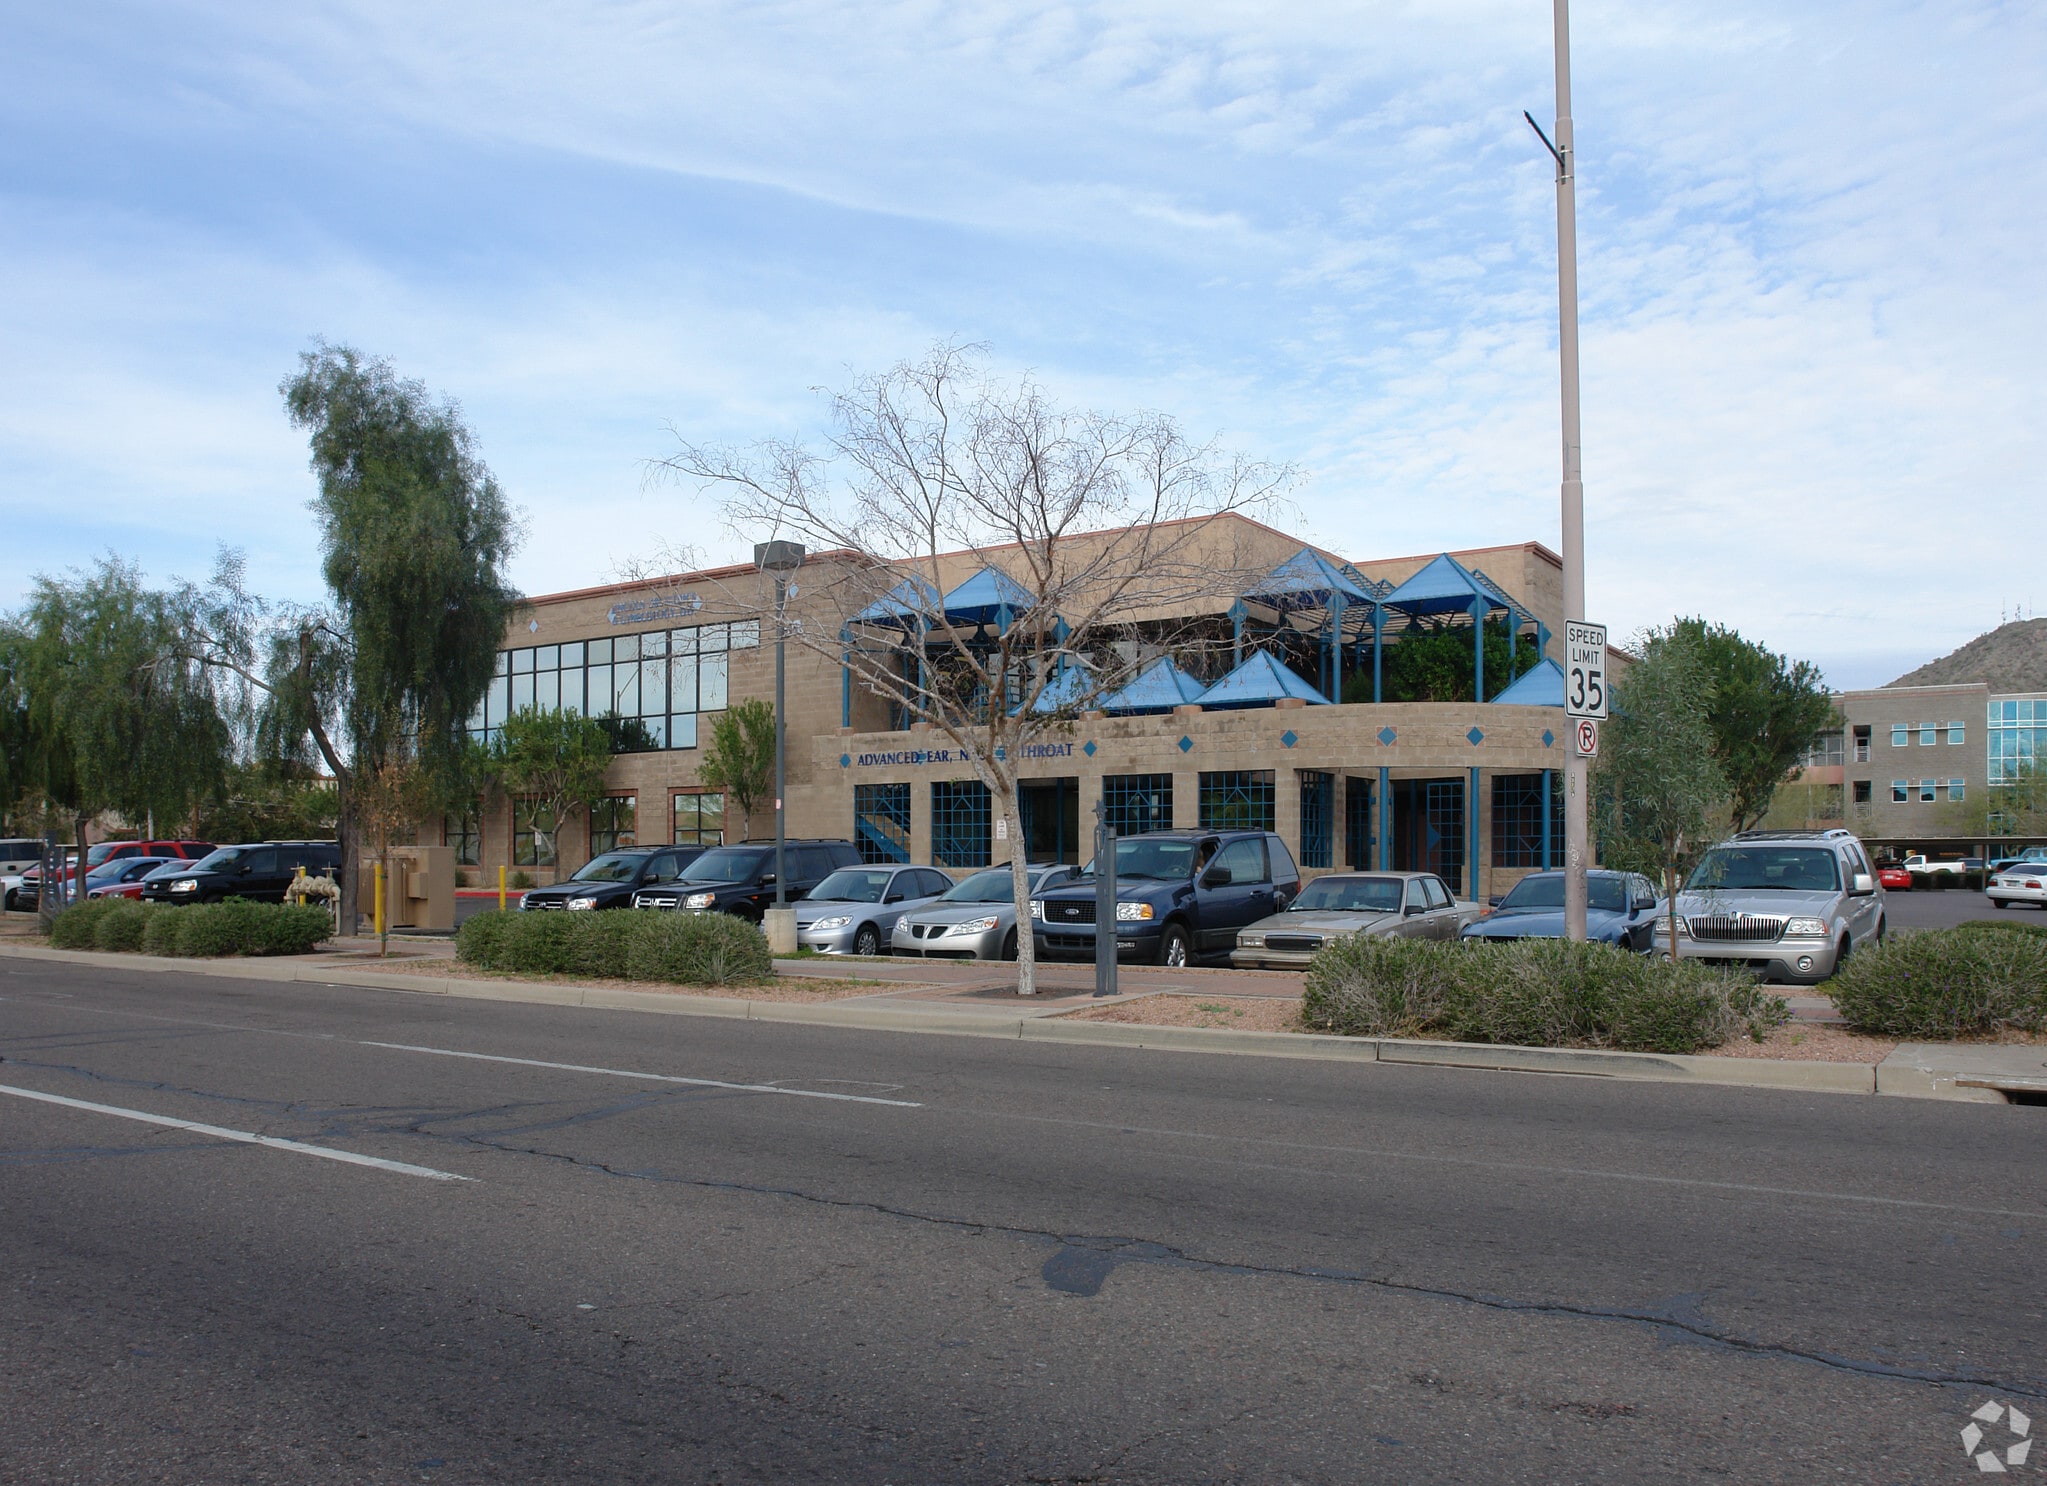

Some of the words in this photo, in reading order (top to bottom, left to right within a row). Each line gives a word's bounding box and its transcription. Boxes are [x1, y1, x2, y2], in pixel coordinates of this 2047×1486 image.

[1569, 628, 1603, 646] SPEED
[1572, 648, 1599, 665] LIMIT
[1570, 667, 1602, 711] 35
[857, 751, 919, 766] ADVANCED
[927, 749, 952, 764] EAR,
